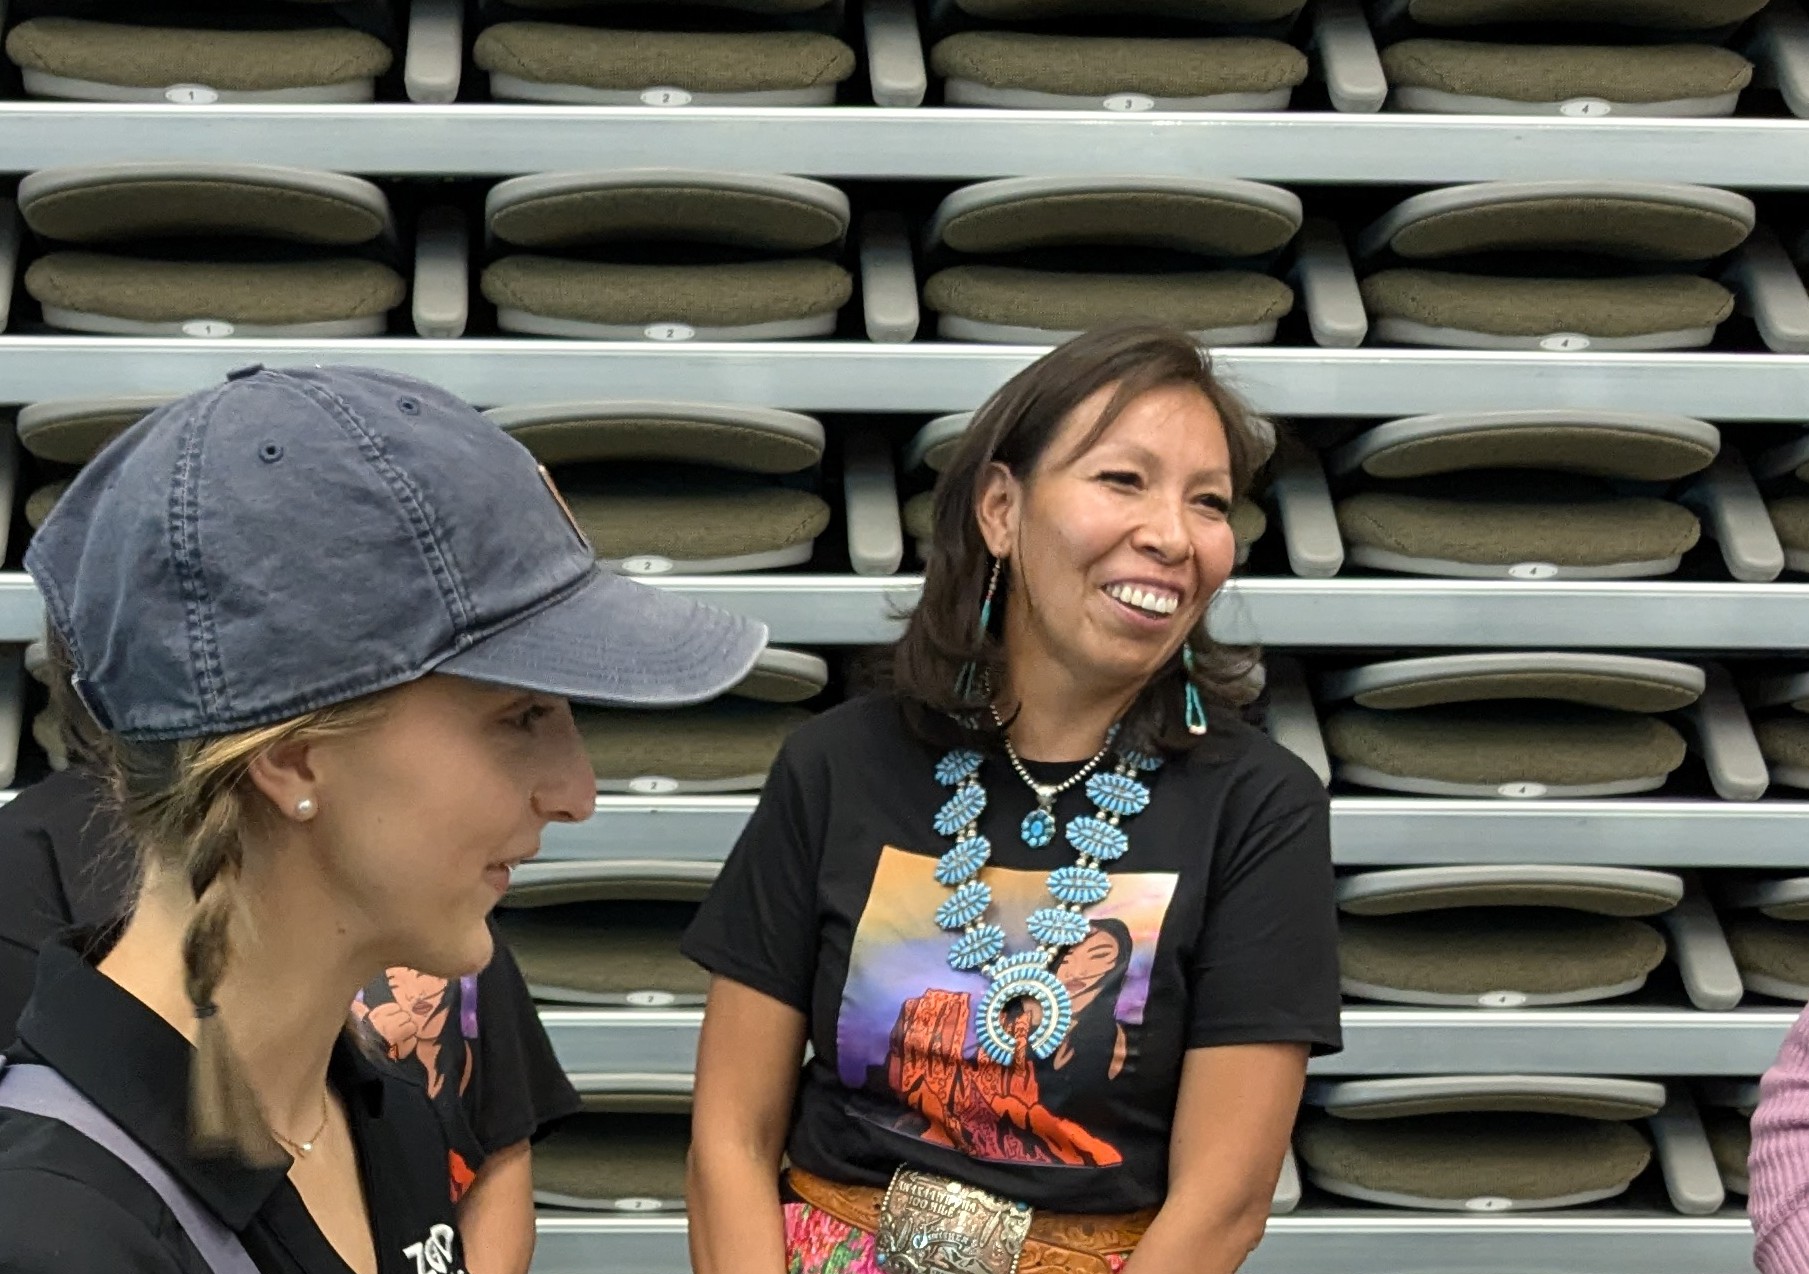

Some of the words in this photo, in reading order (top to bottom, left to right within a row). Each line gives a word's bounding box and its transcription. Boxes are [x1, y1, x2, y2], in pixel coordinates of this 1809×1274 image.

[188, 90, 194, 101] 1
[662, 93, 670, 104] 2
[1125, 99, 1133, 109] 3
[1581, 104, 1589, 114] 4
[205, 325, 211, 334] 1
[666, 328, 675, 338] 2
[1561, 339, 1569, 348] 4
[644, 561, 652, 571] 2
[1529, 567, 1537, 575] 4
[650, 781, 658, 790] 2
[1518, 786, 1526, 794] 4
